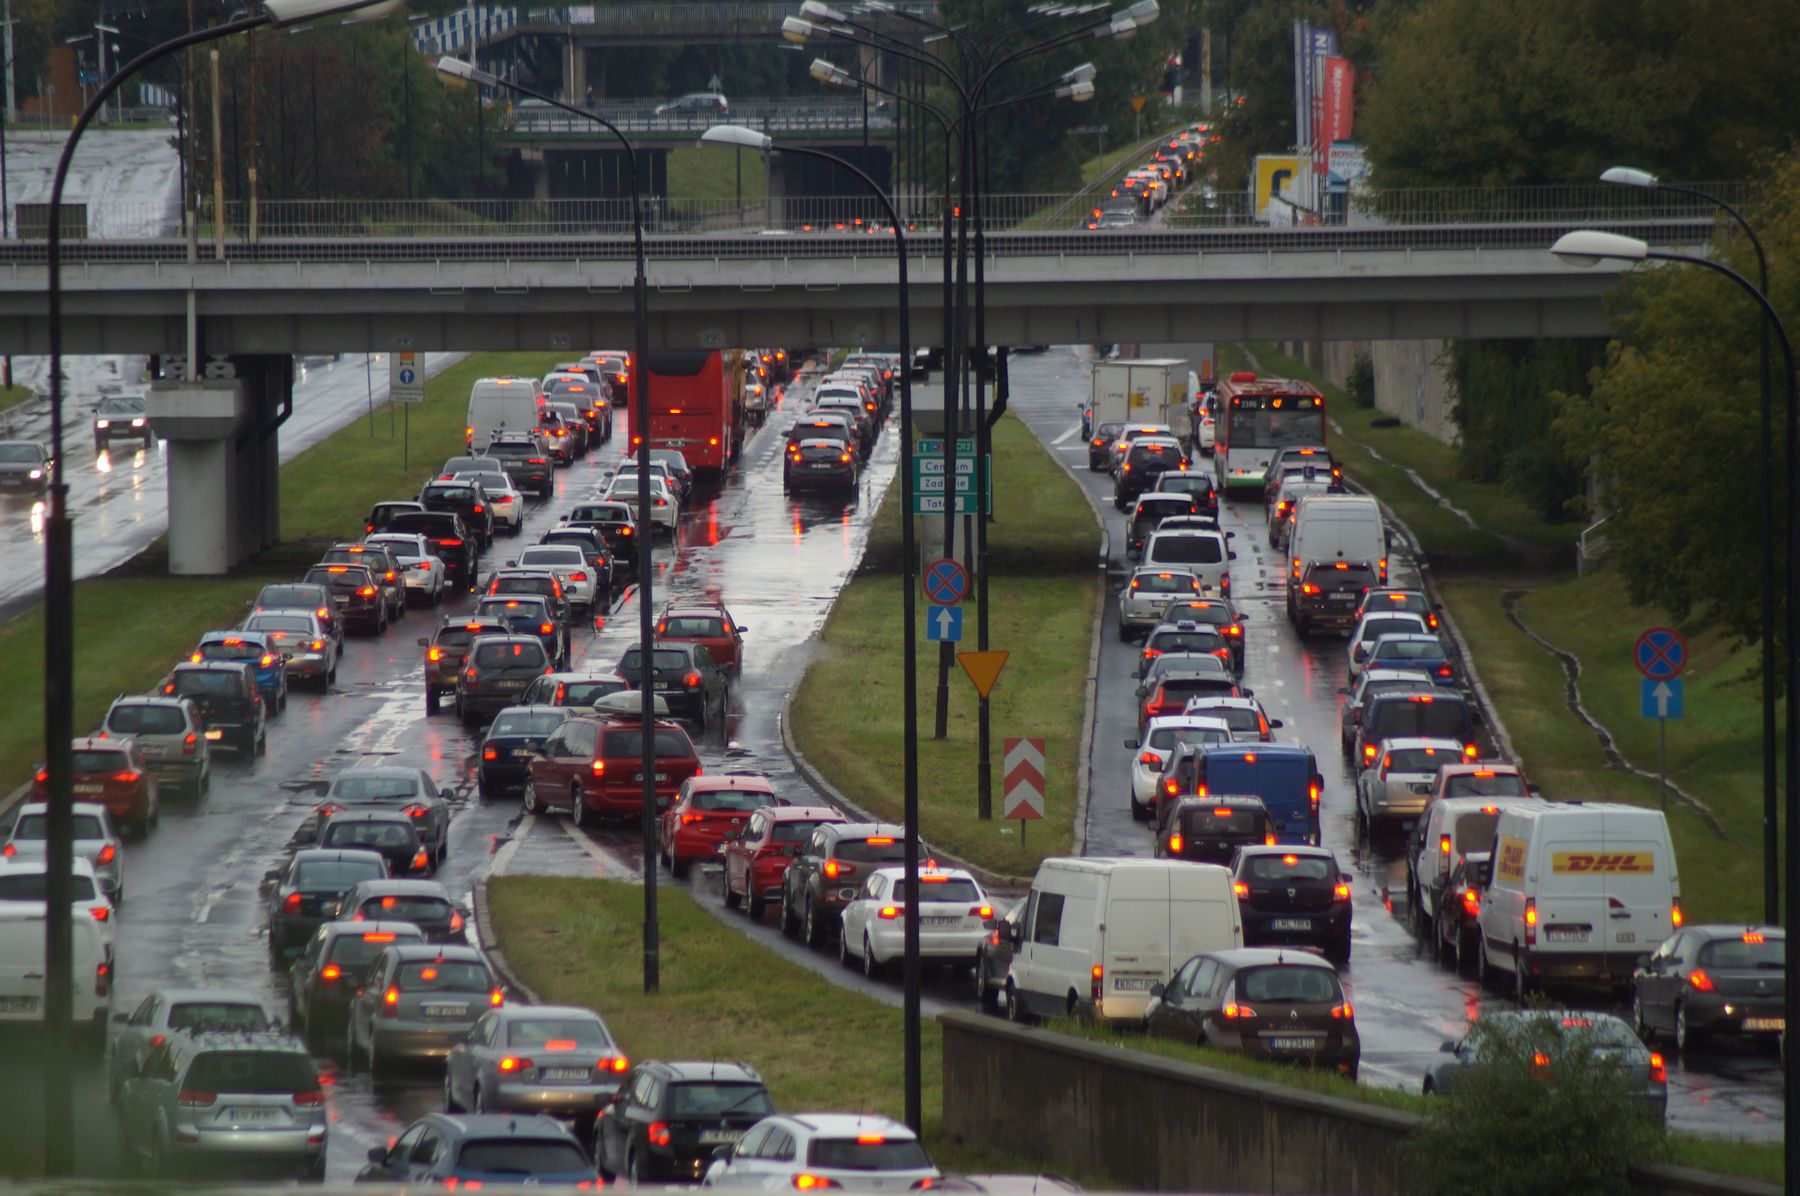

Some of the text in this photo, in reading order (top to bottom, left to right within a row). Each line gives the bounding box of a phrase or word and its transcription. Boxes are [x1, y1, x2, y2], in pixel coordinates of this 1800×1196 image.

[925, 462, 968, 471] Cenum
[925, 478, 966, 488] Zadie
[1567, 855, 1641, 872] DHL
